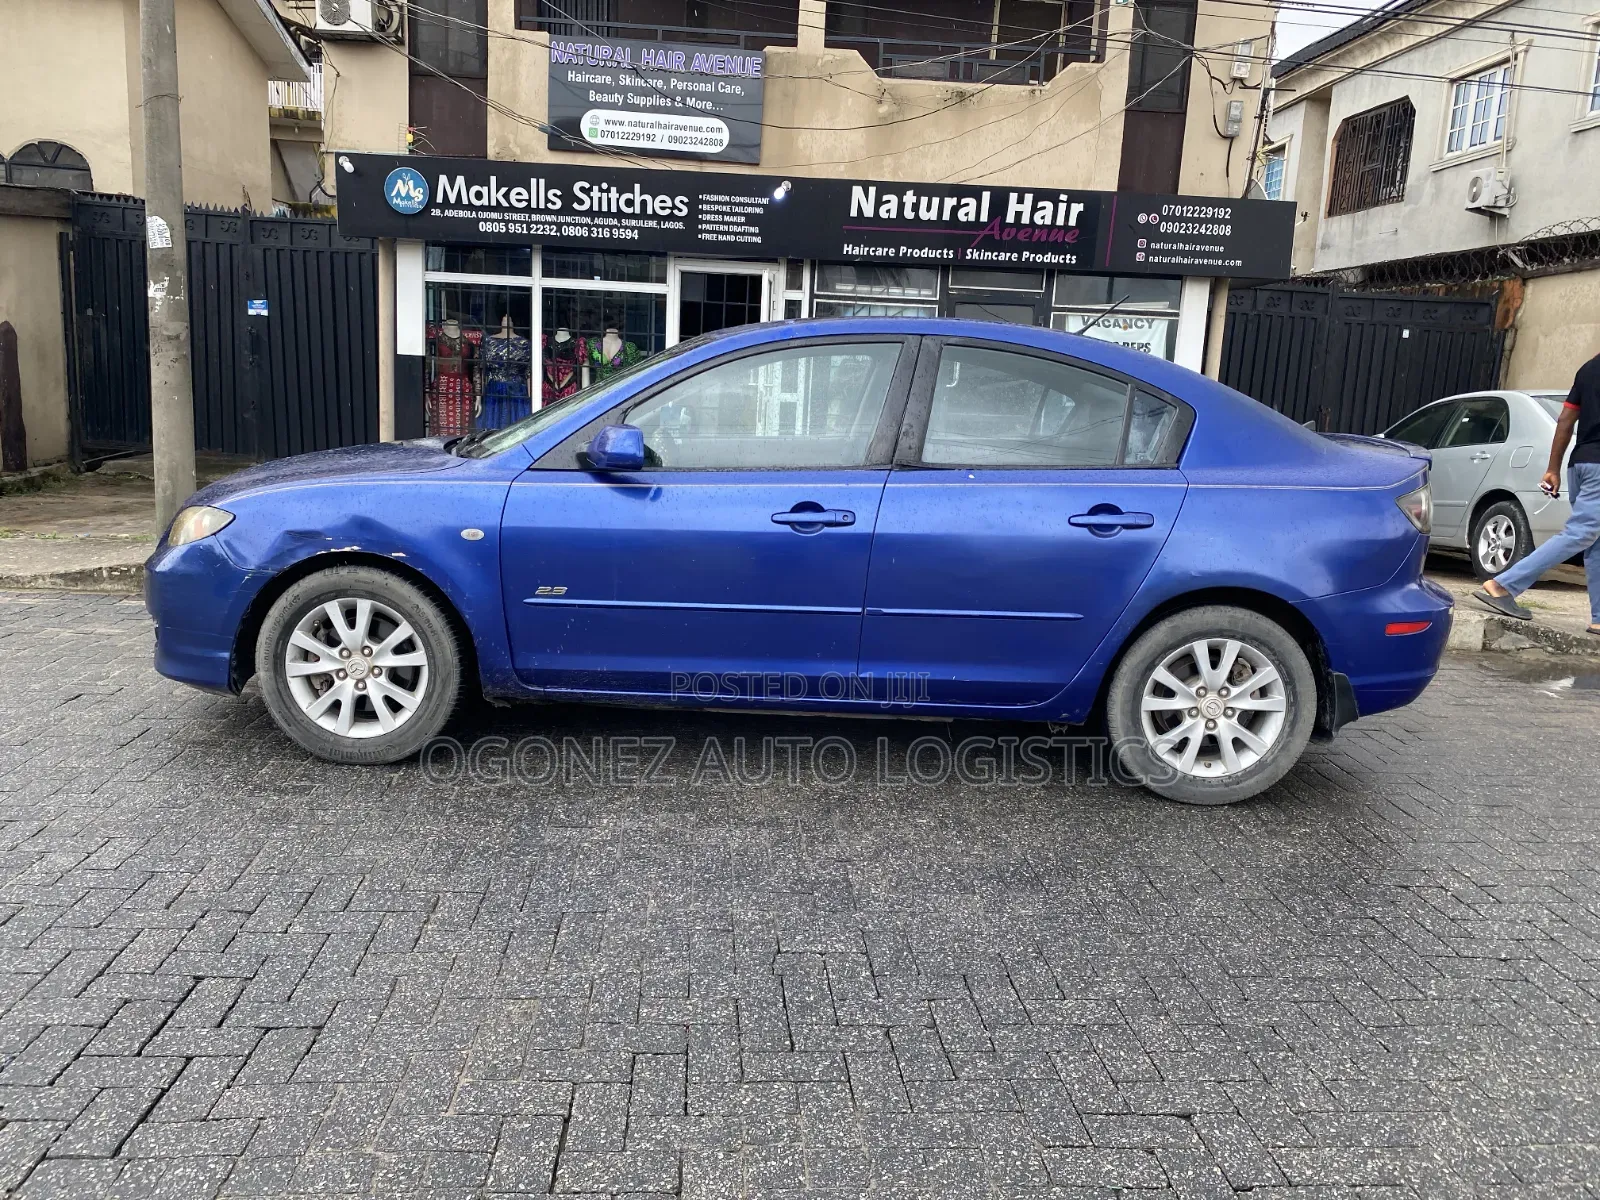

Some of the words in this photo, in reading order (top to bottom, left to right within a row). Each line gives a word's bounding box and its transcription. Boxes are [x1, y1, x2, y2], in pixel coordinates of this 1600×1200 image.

[551, 41, 637, 68] NATURAL
[641, 48, 686, 73] HAIR
[690, 53, 763, 77] AVENUE
[567, 71, 615, 87] Haircare,
[618, 74, 667, 90] Skincare,
[670, 78, 715, 93] Personal
[718, 82, 745, 97] Care,
[589, 90, 624, 106] Beauty
[627, 93, 672, 108] Supplies
[674, 96, 683, 108] &
[686, 97, 724, 111] More...
[604, 118, 723, 134] www.naturalhairavenue.com
[600, 129, 656, 143] 07012229192
[667, 134, 724, 147] 09023242808
[436, 174, 563, 210] Makells
[572, 181, 689, 217] Stitches
[702, 194, 730, 202] FASHION
[731, 196, 770, 205] CONSULTANT
[702, 204, 731, 212] BESPOKE
[731, 205, 764, 214] TAILORING
[849, 185, 991, 223] Natural
[1005, 192, 1084, 226] Hair
[1162, 204, 1232, 219] 07012229192
[430, 208, 444, 218] 2B,
[444, 210, 477, 219] ADEBOLA
[478, 211, 503, 220] OJOMU
[504, 212, 531, 222] STREET,
[531, 214, 557, 222] BROWN
[557, 215, 594, 226] JUNCTION,
[594, 217, 621, 227] AGUDA,
[621, 219, 660, 229] SURULERE,
[661, 221, 686, 230] LAGOS.
[702, 213, 723, 221] DRESS
[724, 215, 746, 223] MAKER
[478, 221, 507, 233] 0805
[508, 222, 529, 234] 951
[529, 223, 561, 237] 2232,
[561, 225, 589, 237] 0806
[590, 227, 611, 238] 316
[612, 228, 639, 240] 9594
[702, 223, 728, 231] PATTERN
[729, 225, 759, 233] DRAFTING
[970, 216, 1080, 247] Avenue
[1160, 221, 1232, 236] 09023242808
[702, 233, 718, 241] FREE
[718, 234, 736, 242] HAND
[736, 235, 762, 243] CUTTING
[843, 243, 895, 257] Haircare
[899, 246, 954, 259] Products
[965, 248, 1018, 262] Skincare
[1022, 251, 1077, 265] Products
[1150, 242, 1225, 253] naturalhairavenue
[1148, 255, 1243, 267] naturalhairavenue.com
[1081, 315, 1156, 330] VACANCY
